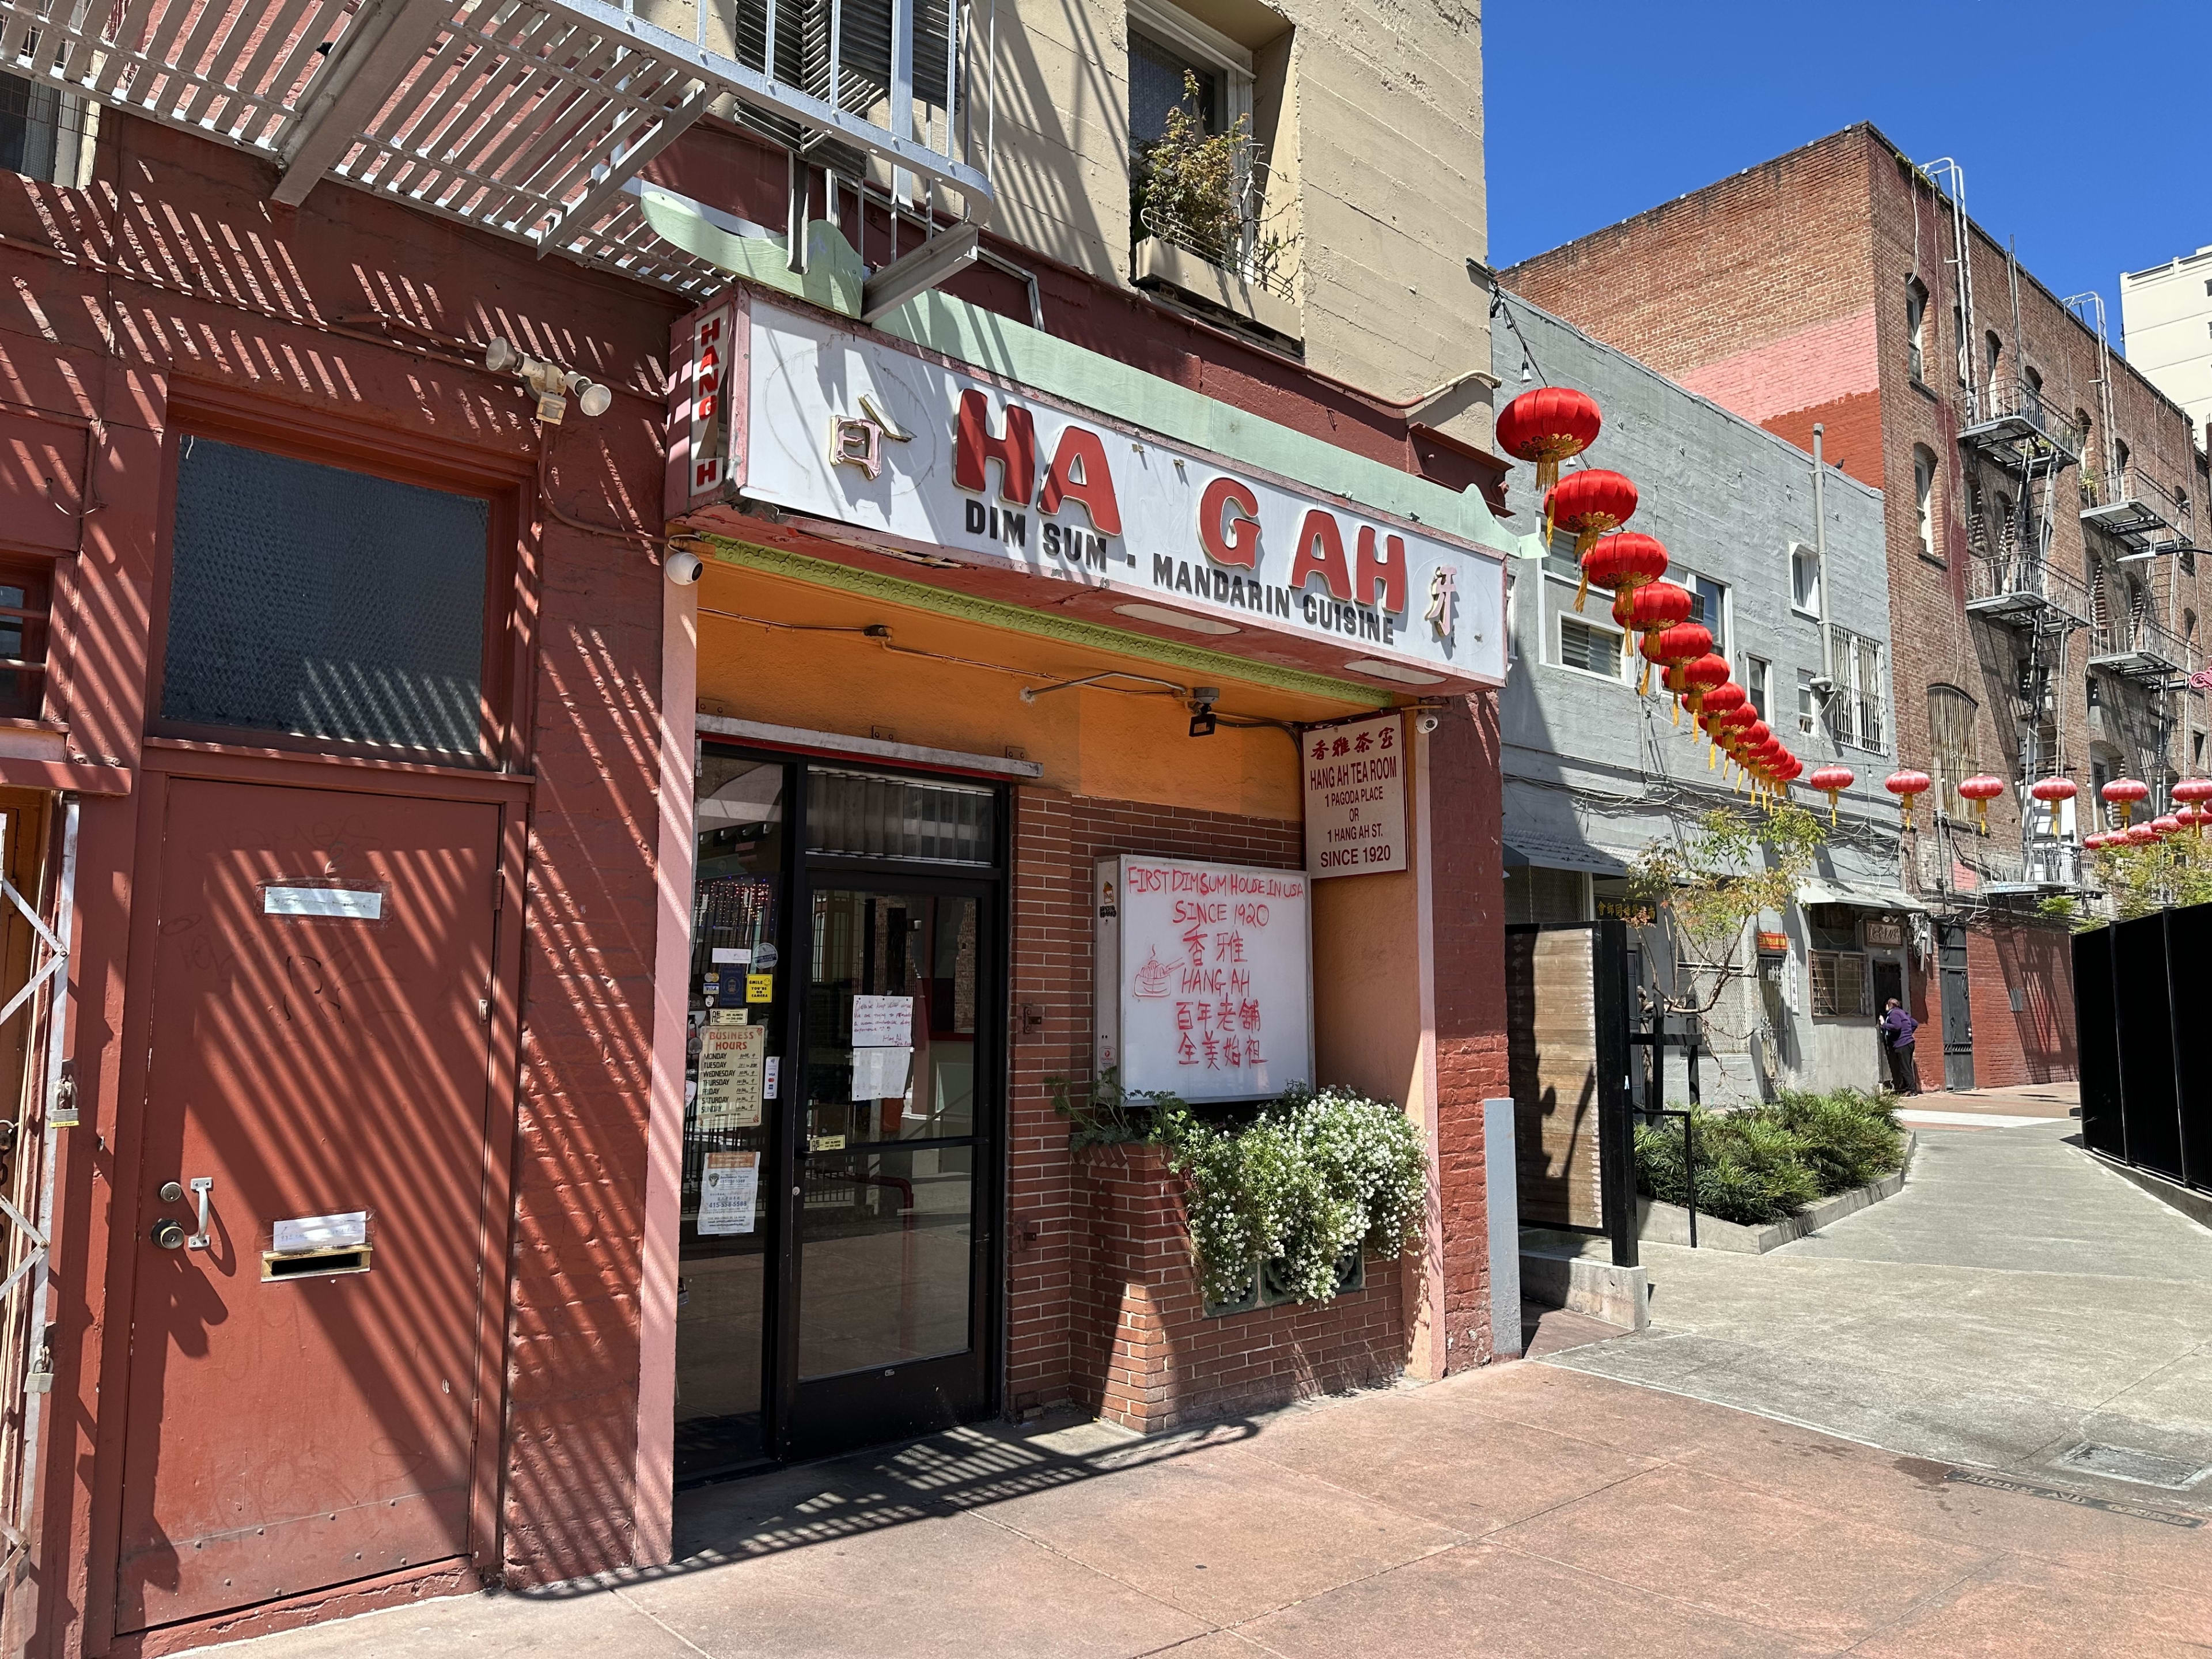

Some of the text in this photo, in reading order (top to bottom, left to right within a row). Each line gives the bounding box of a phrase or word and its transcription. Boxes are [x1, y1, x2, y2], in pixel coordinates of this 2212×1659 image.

[966, 499, 1026, 547] DIM
[1043, 522, 1107, 573] SUM
[1153, 552, 1290, 619] MANDARIN
[1303, 594, 1394, 645] CUISINE
[1310, 756, 1397, 790] HANG AH TEA ROOM
[1324, 786, 1383, 807] 1 PAGODA PLACE
[1349, 808, 1359, 822] OR
[1327, 823, 1383, 843] 1 HANG AH ST.
[1320, 845, 1391, 868] SINCE 1920
[1128, 866, 1169, 895] FIRST
[1230, 874, 1265, 894] HOUSE
[1266, 881, 1281, 897] IN
[1283, 882, 1305, 900] USA
[1172, 900, 1270, 928] SINCE 1920
[1180, 968, 1251, 997] HANG AH
[709, 1031, 754, 1040] BUSINESS
[715, 1041, 748, 1051] HOURS
